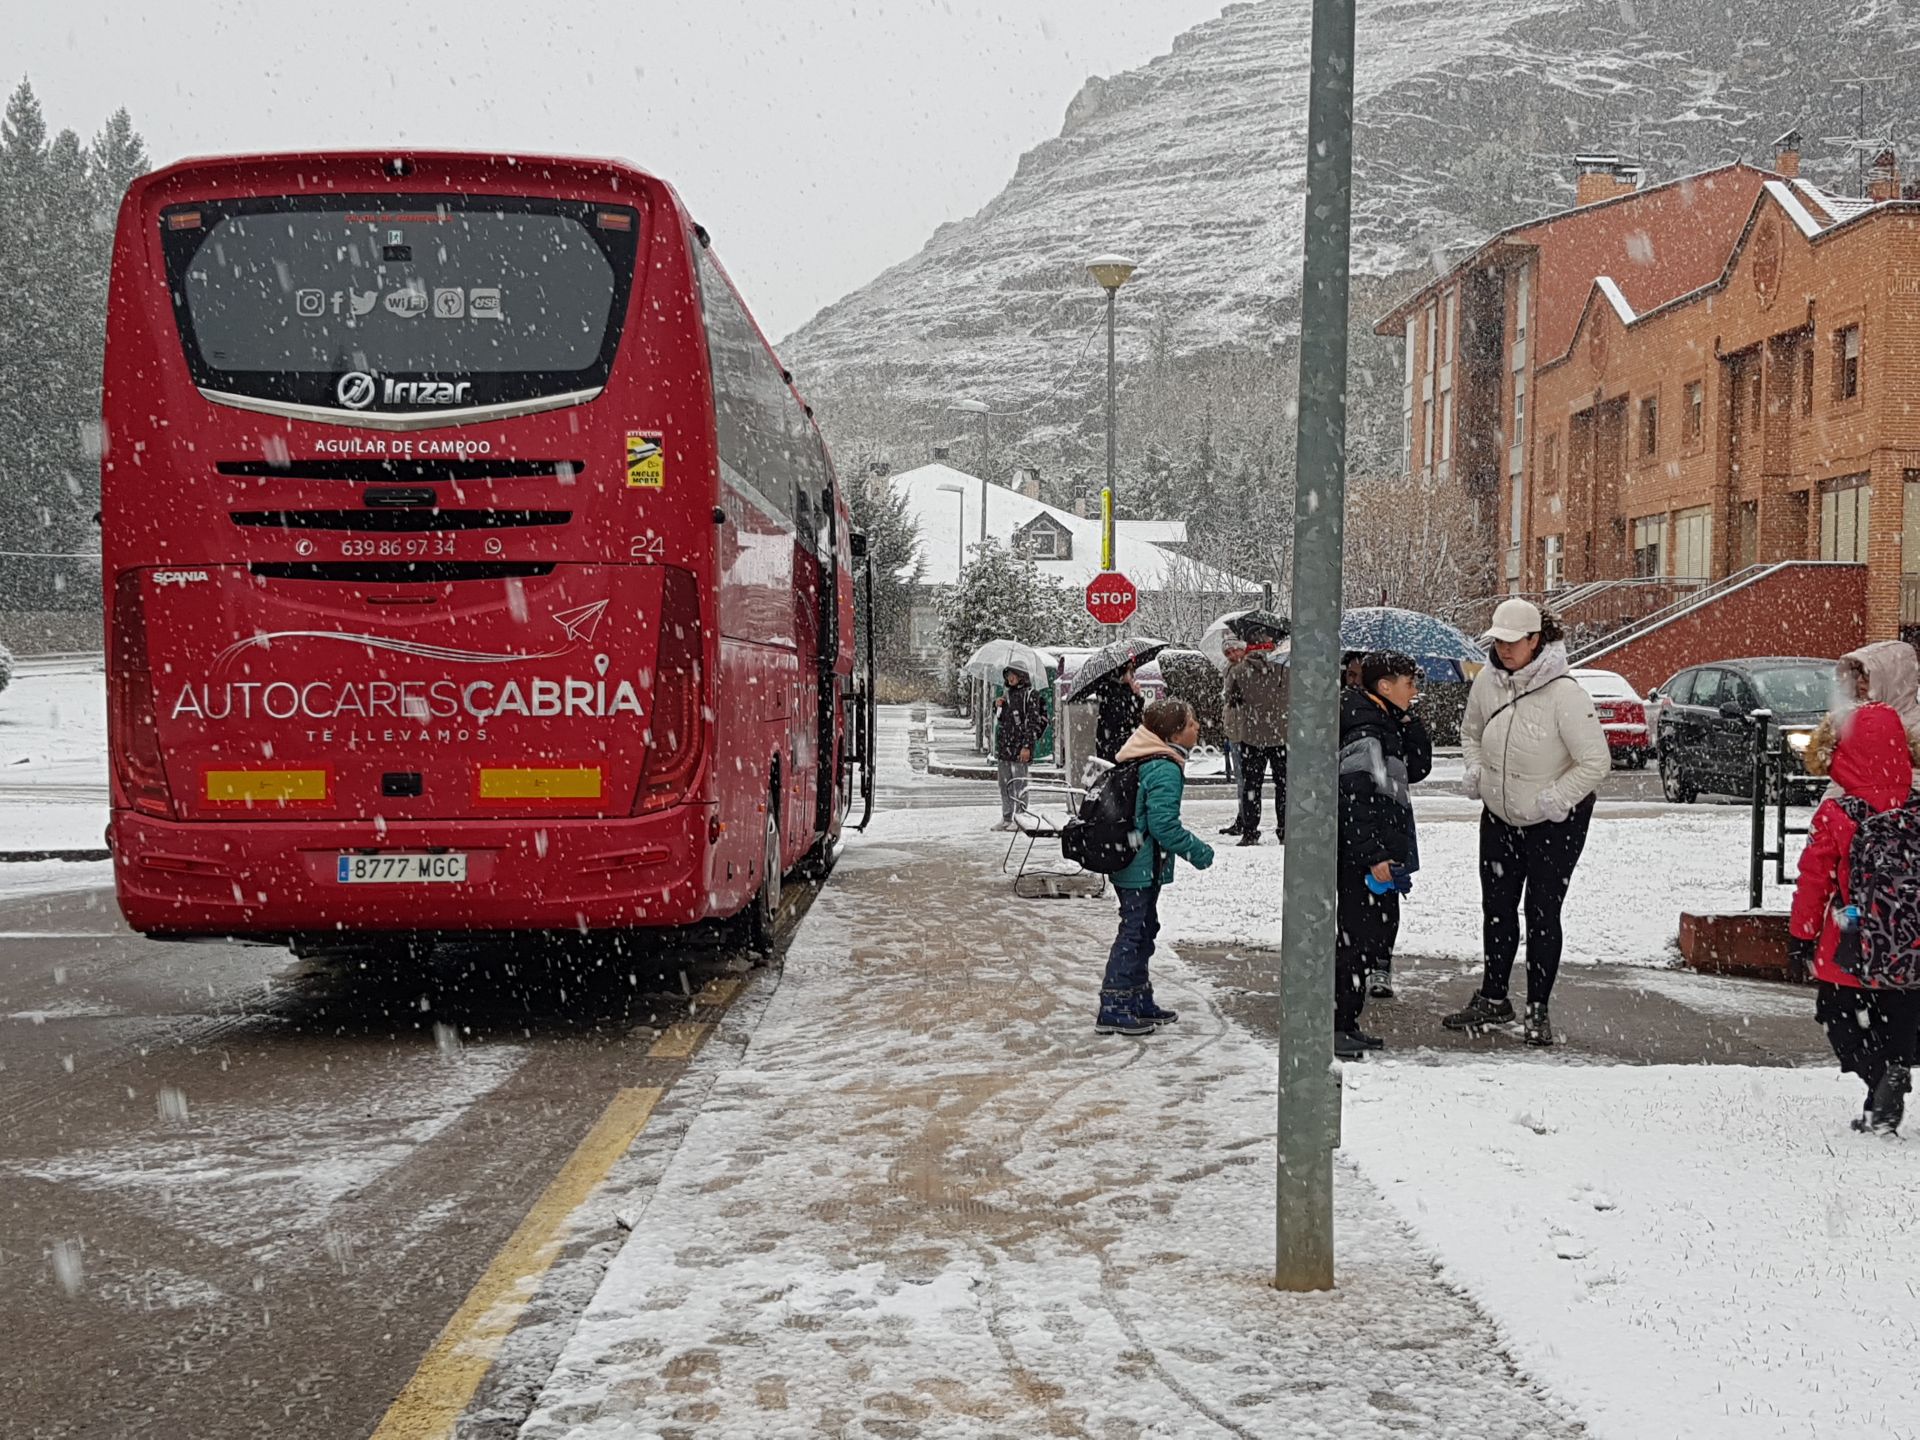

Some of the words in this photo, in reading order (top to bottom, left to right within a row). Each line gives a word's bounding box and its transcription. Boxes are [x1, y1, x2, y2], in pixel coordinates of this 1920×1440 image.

[475, 298, 501, 308] USB
[315, 440, 386, 453] AGUILAR
[392, 440, 413, 453] DE
[418, 440, 490, 453] CAMPOO
[341, 539, 375, 555] 639
[379, 539, 401, 555] 86
[406, 539, 429, 555] 97
[434, 539, 456, 555] 34
[631, 535, 665, 557] 24
[152, 571, 209, 583] SCANIA
[1090, 592, 1132, 605] STOP
[306, 730, 333, 742] TE
[351, 729, 487, 742] LLEVAMOS
[355, 858, 410, 879] 8777
[418, 857, 460, 878] MGC
